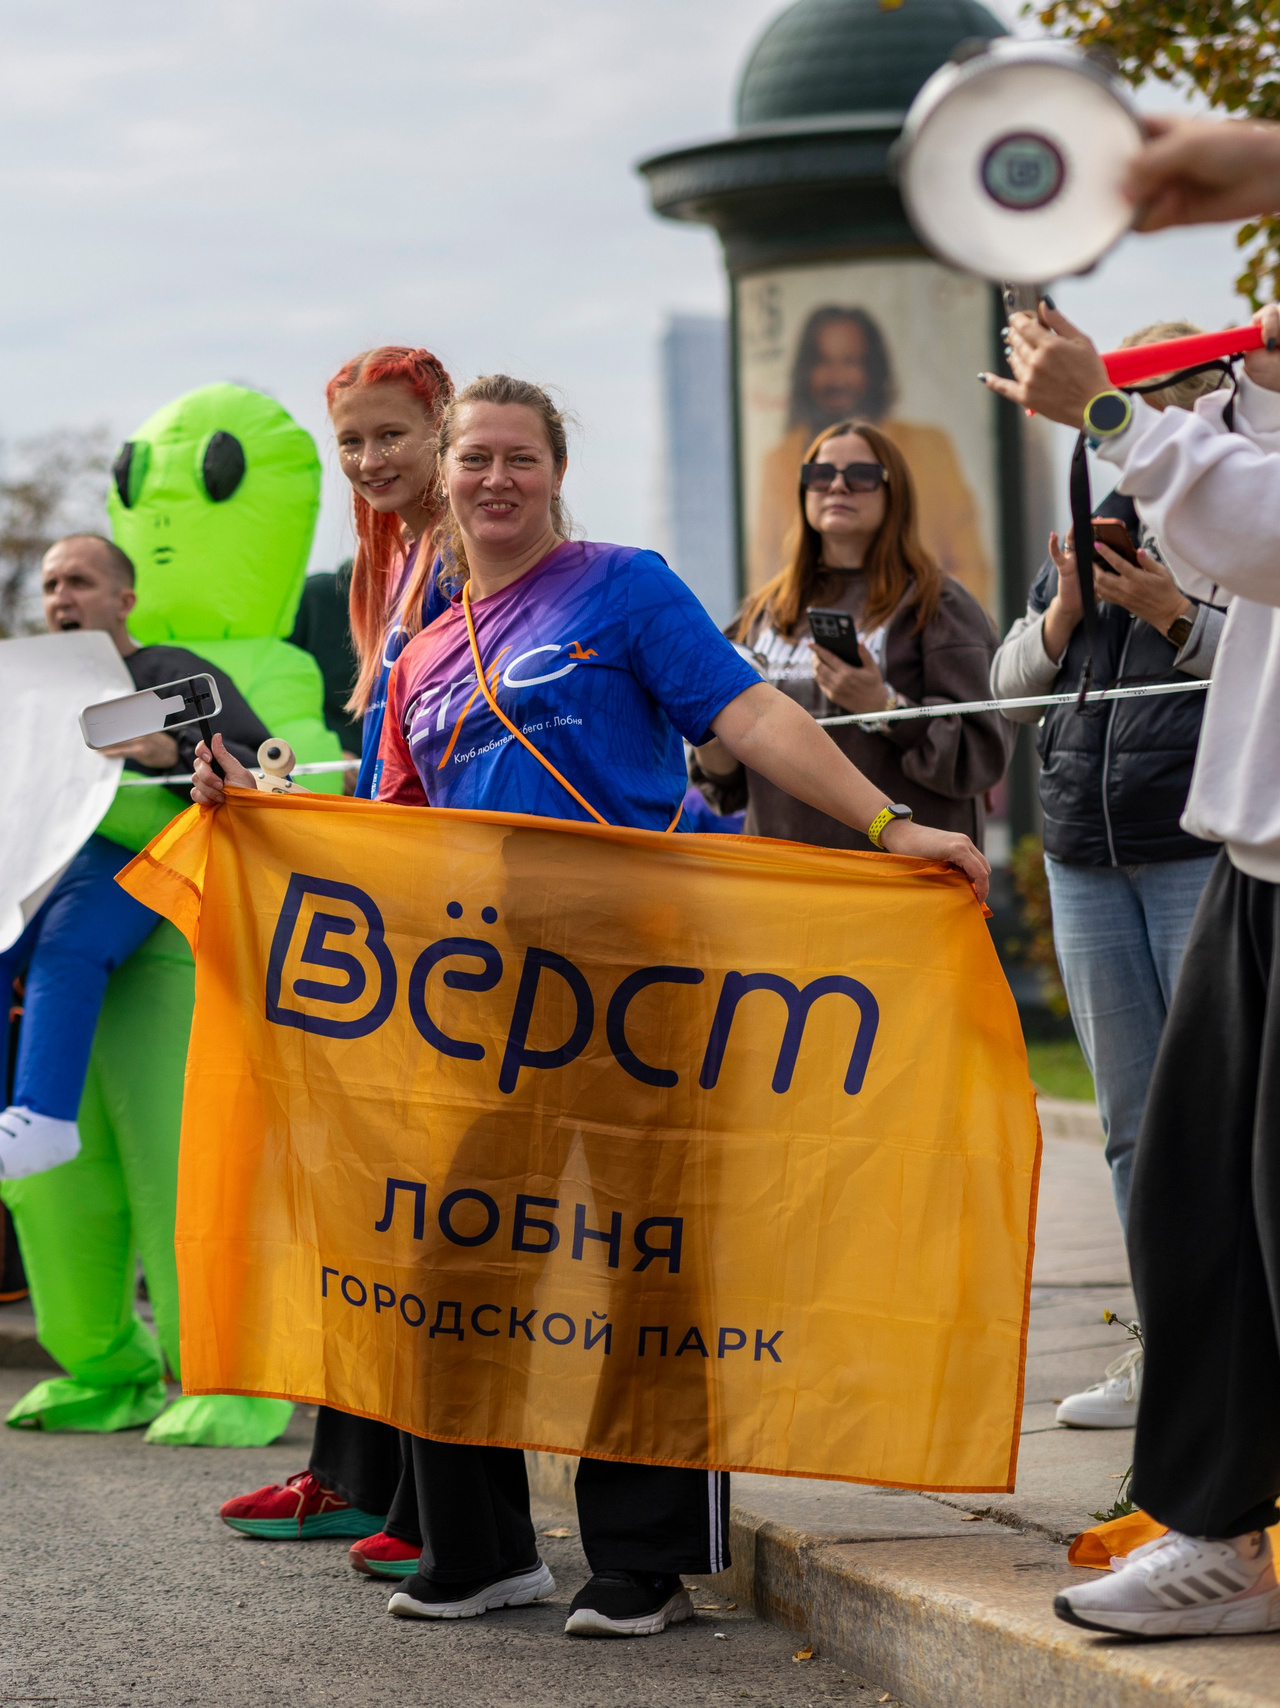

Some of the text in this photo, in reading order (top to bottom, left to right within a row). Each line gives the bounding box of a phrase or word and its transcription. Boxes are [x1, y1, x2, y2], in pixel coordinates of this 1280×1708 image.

[453, 746, 476, 764] Клуб
[522, 722, 543, 735] бега
[545, 720, 552, 729] г.
[553, 714, 583, 727] Лобня
[266, 872, 880, 1095] Вёрст
[375, 1177, 684, 1274] ЛОБНЯ
[321, 1266, 784, 1363] ГОРОДСКОЙ ПАРК
